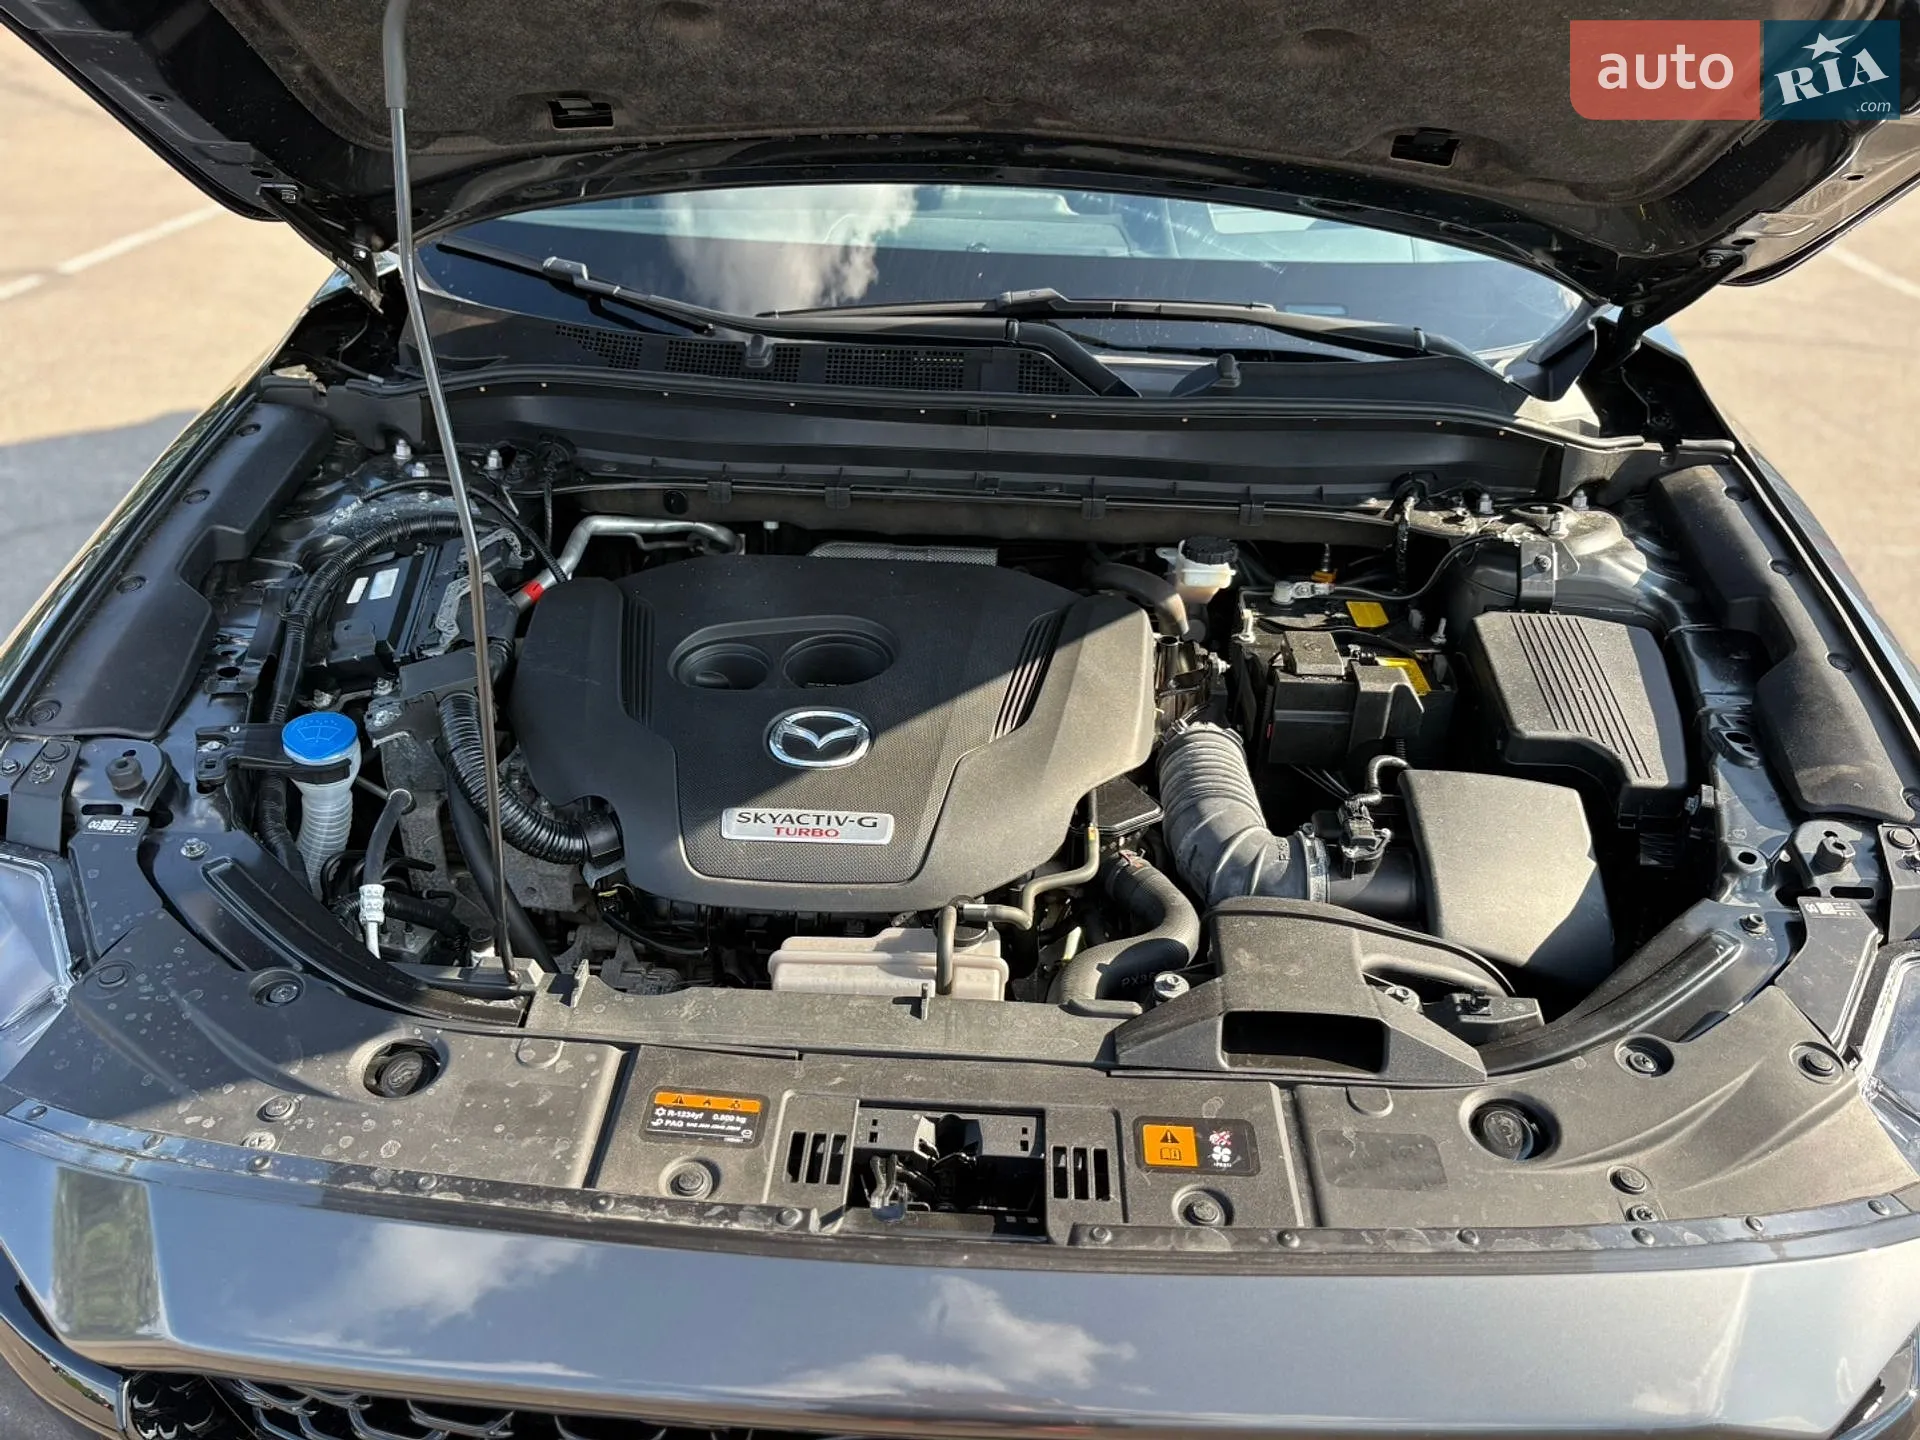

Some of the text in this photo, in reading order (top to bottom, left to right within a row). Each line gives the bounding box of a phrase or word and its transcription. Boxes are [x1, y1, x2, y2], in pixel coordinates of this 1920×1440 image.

[736, 811, 878, 828] SKYACTIV-G
[774, 826, 840, 838] TURBO
[664, 1119, 684, 1128] PAG
